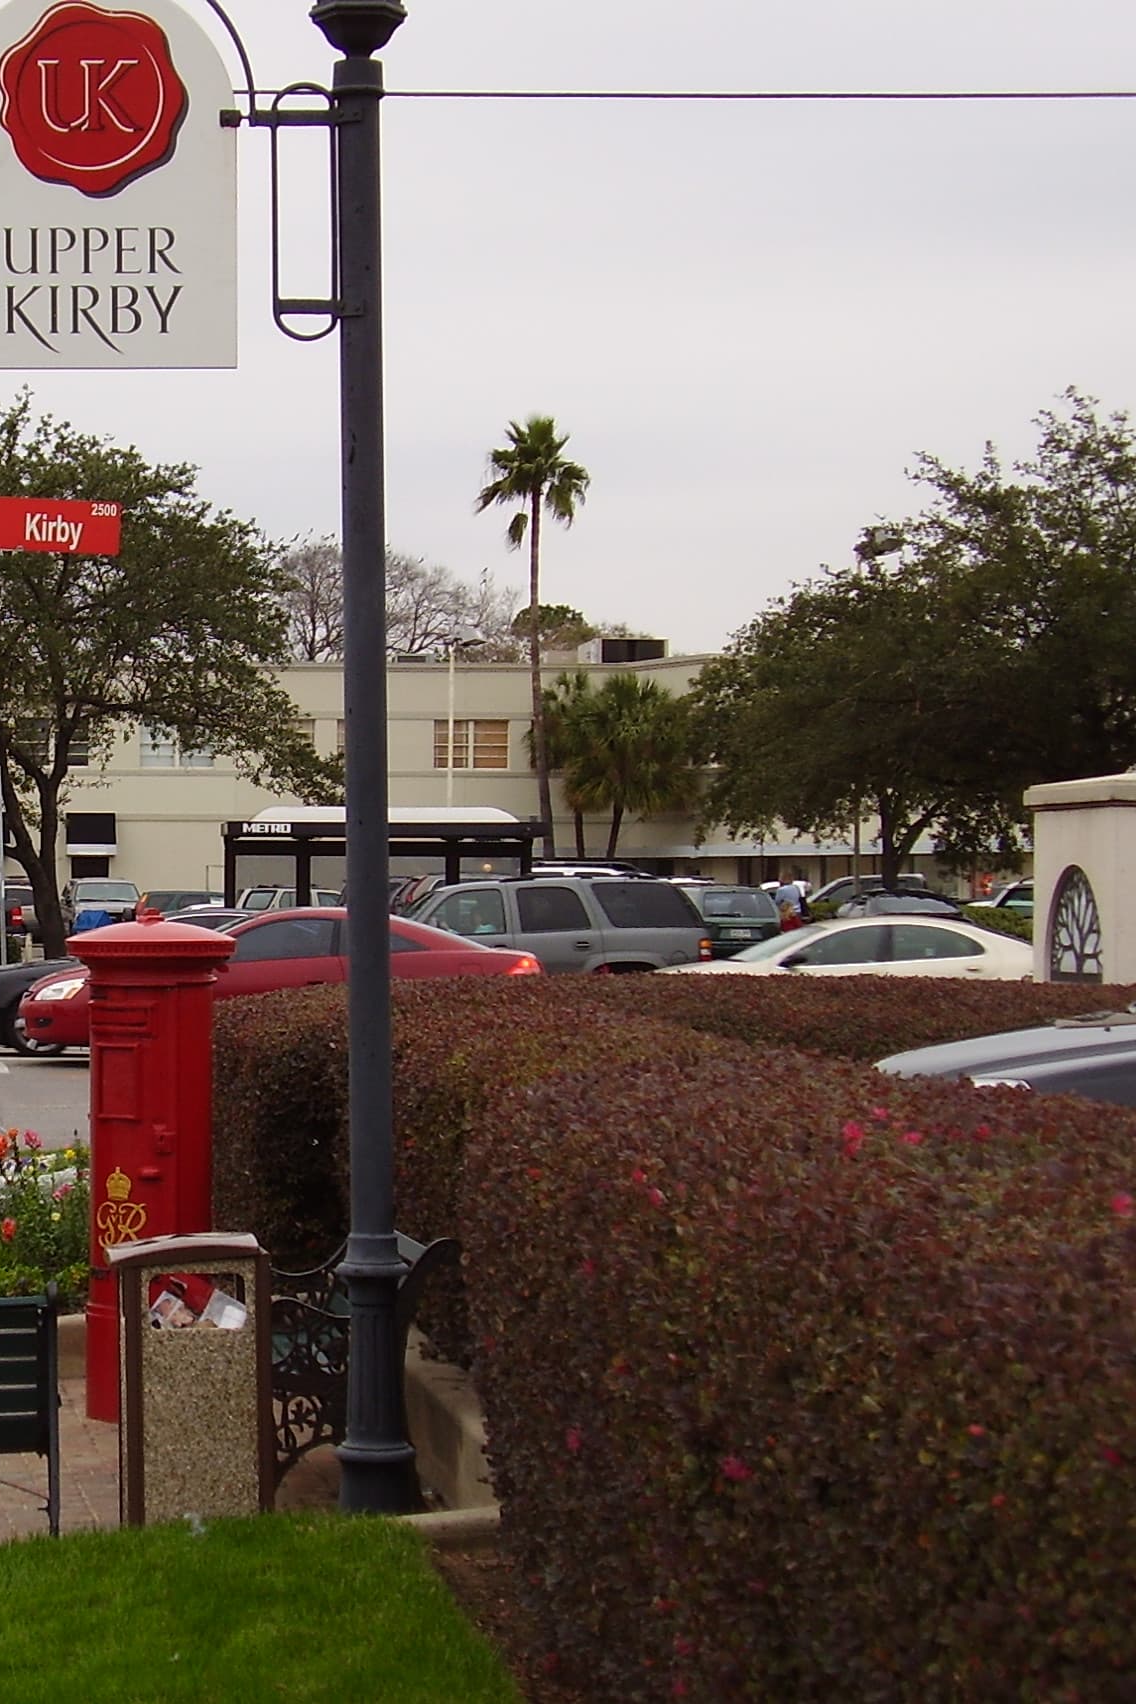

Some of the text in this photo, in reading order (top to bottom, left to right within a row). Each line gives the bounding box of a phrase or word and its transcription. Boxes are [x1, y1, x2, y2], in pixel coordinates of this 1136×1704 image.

[37, 60, 143, 132] UK
[3, 227, 183, 274] UPPER
[5, 285, 184, 354] KIRBY
[91, 503, 117, 516] 2500
[25, 513, 83, 550] Kirby
[242, 823, 292, 834] METRO
